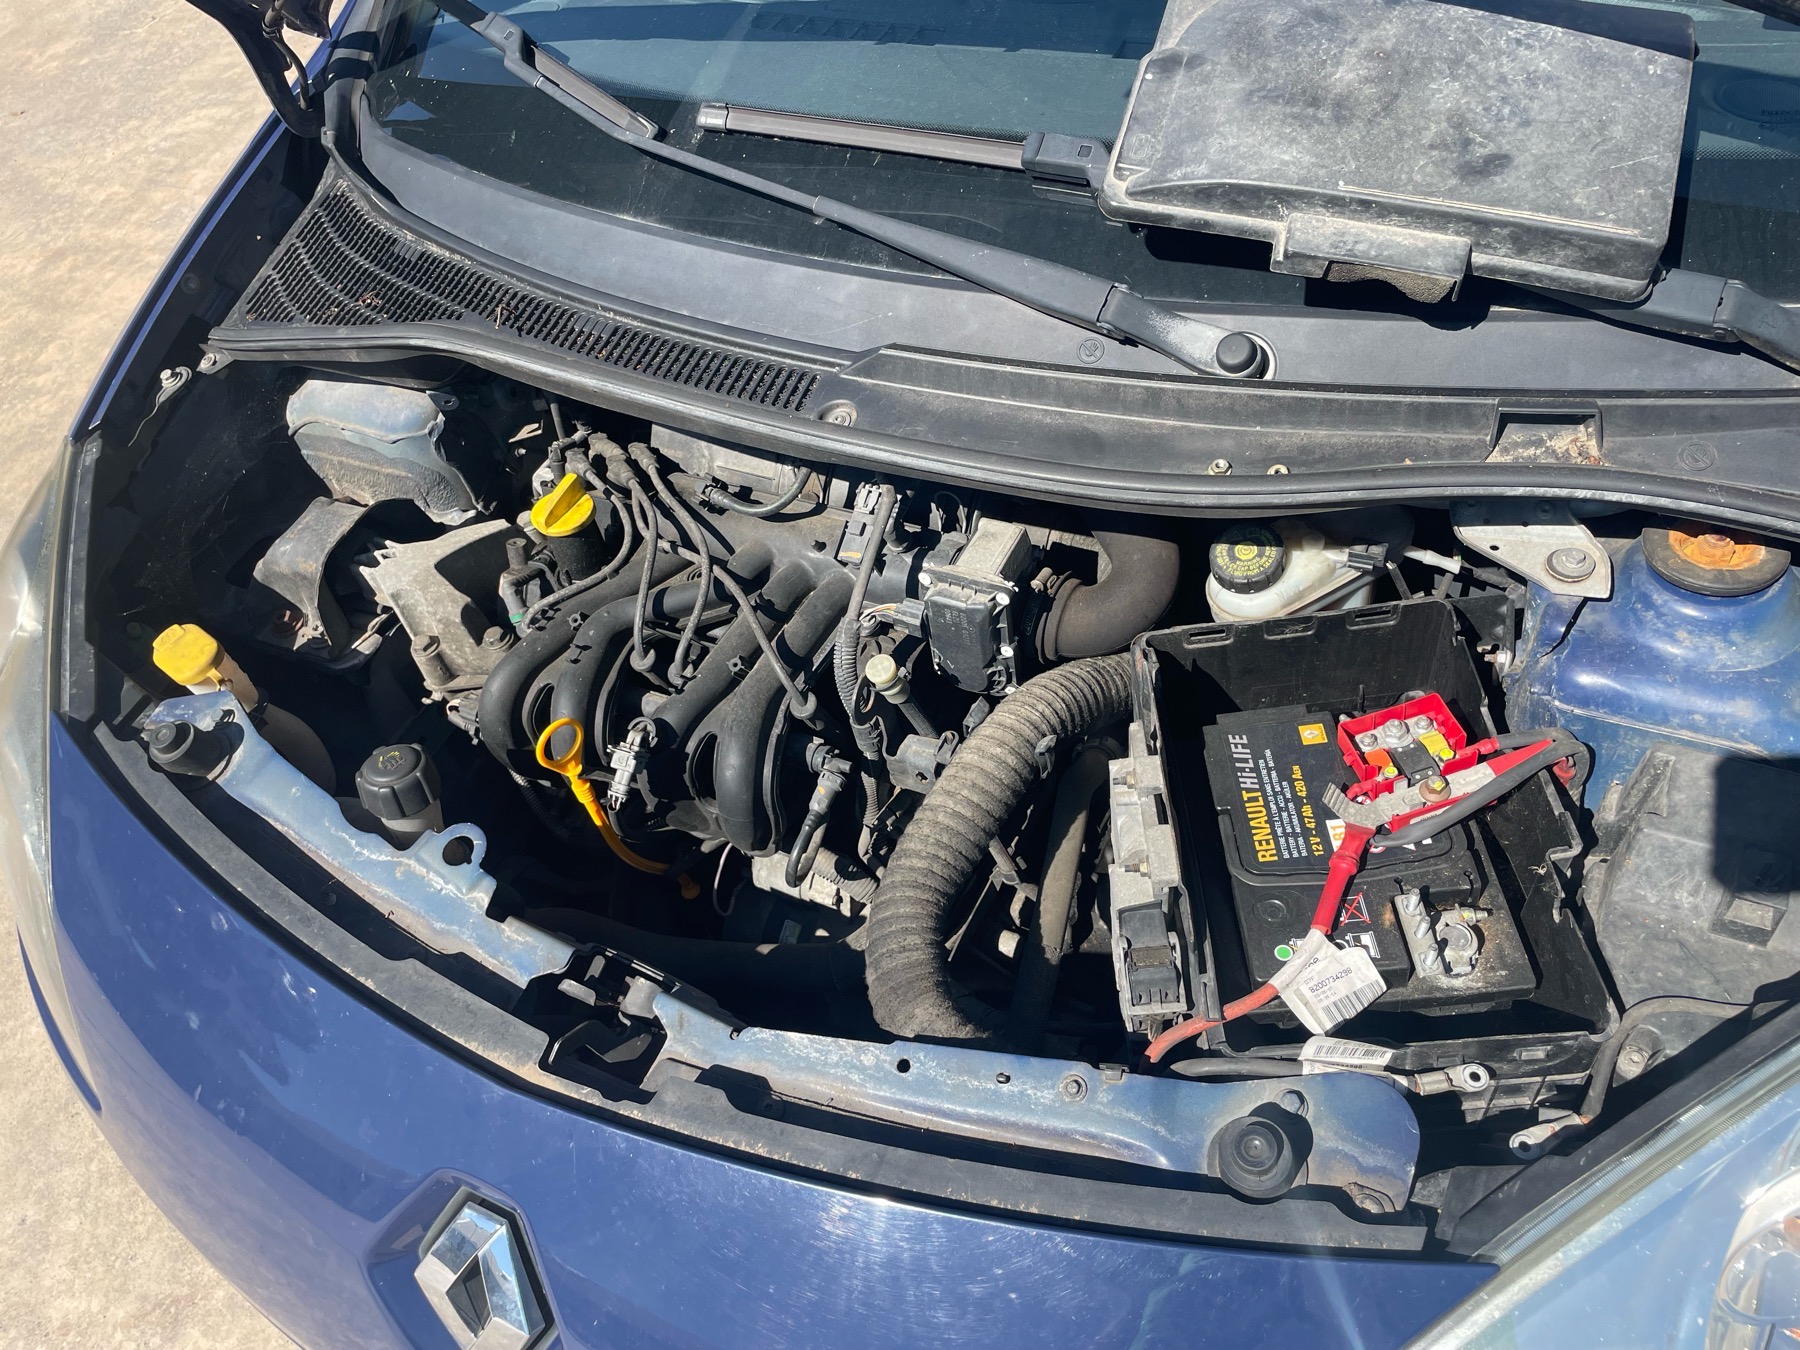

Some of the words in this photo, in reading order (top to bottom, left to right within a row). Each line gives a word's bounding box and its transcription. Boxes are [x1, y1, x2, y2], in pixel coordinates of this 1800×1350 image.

[1236, 556, 1261, 566] WARNING
[1264, 783, 1273, 796] SANS
[1294, 781, 1307, 797] 420
[1242, 790, 1279, 863] RENAULT
[1281, 811, 1292, 832] BATTERIE
[1278, 836, 1290, 858] BATTERIE
[1288, 837, 1299, 858] BATTERY
[1308, 967, 1353, 994] 8200734298
